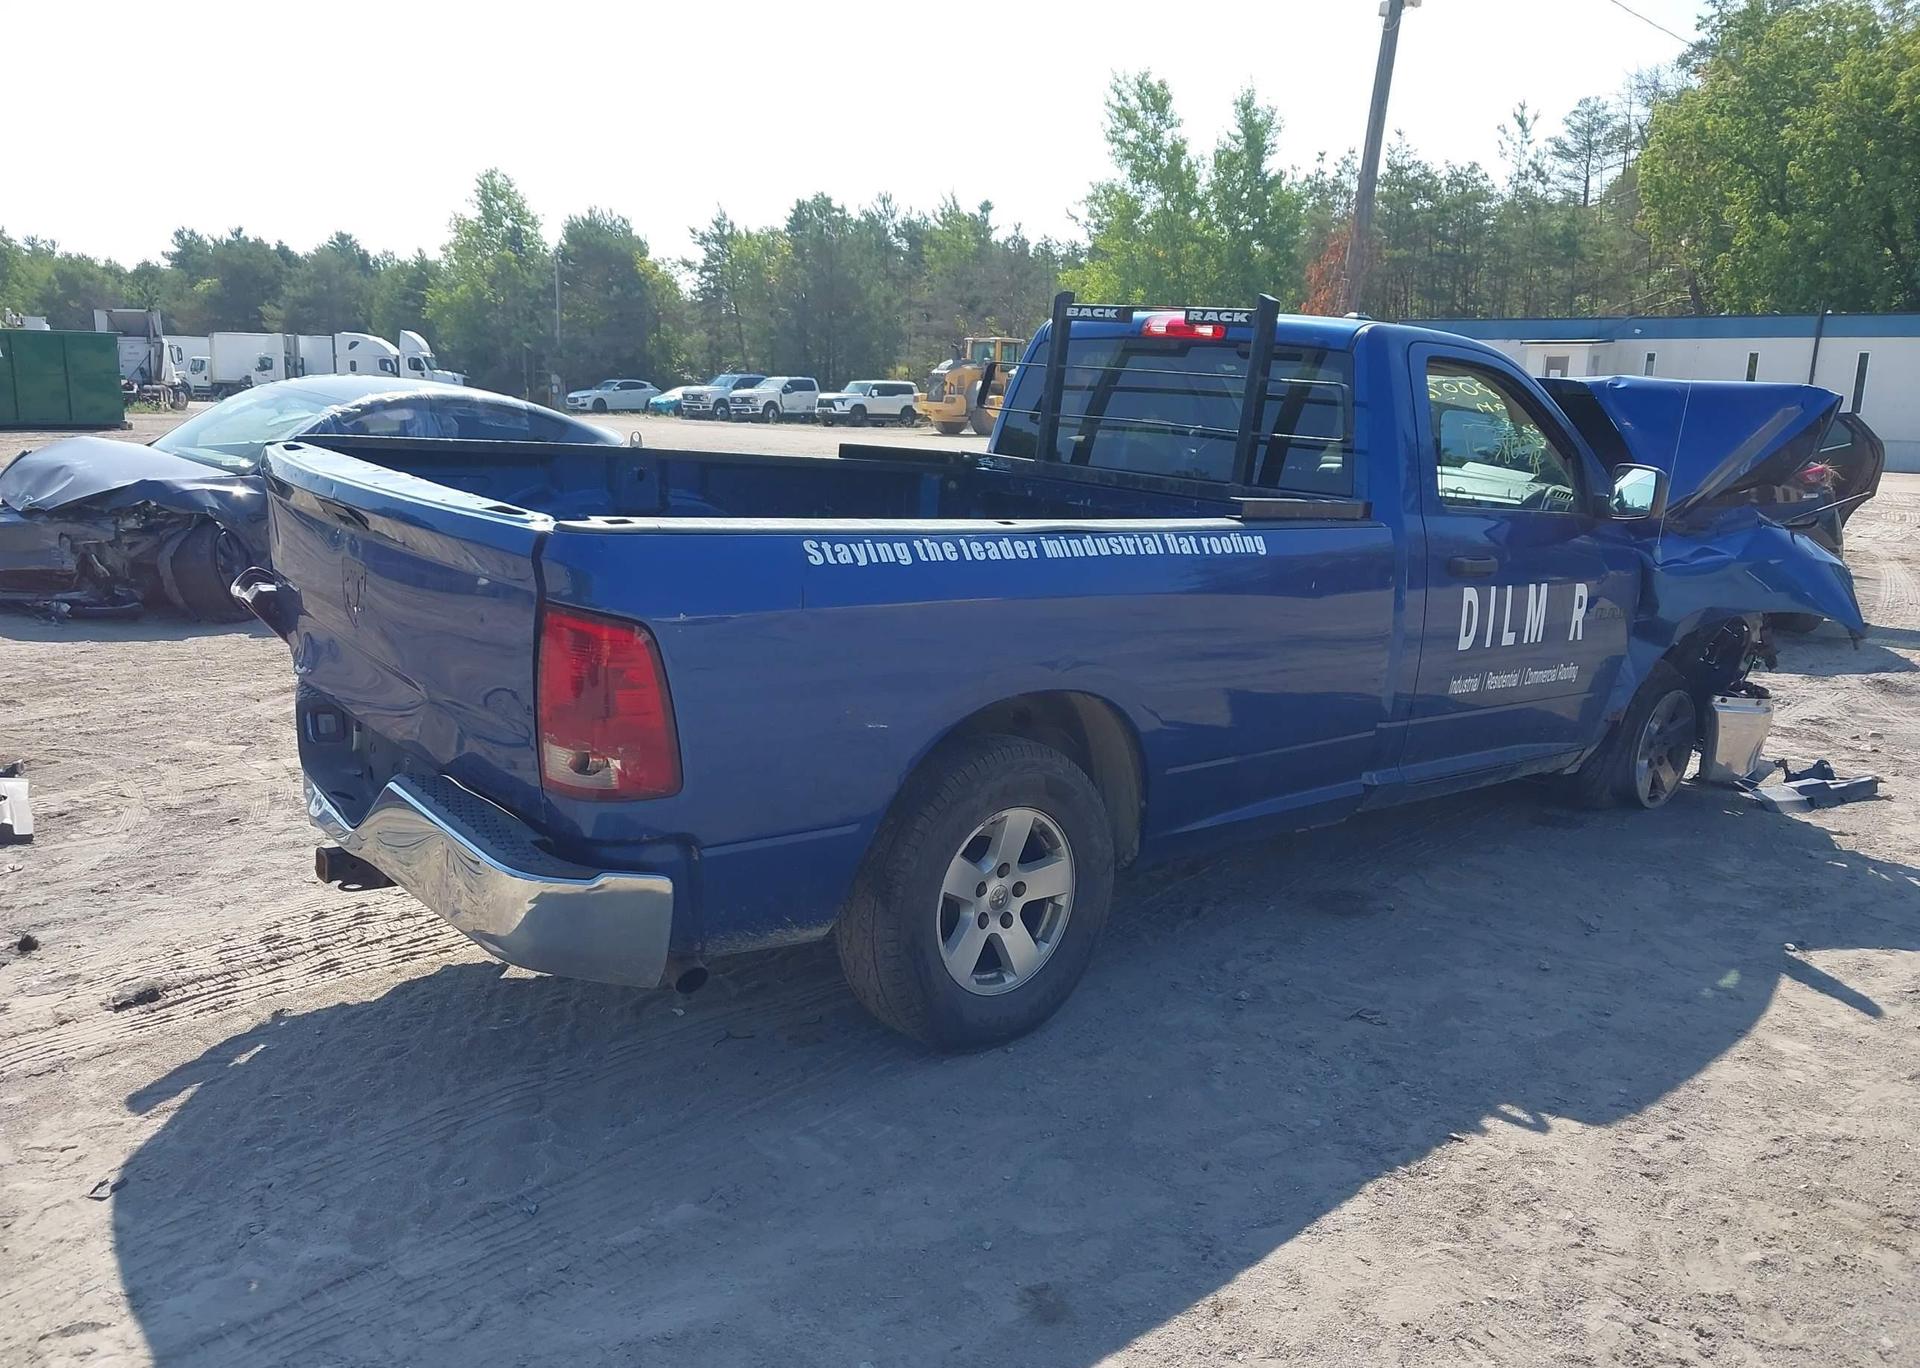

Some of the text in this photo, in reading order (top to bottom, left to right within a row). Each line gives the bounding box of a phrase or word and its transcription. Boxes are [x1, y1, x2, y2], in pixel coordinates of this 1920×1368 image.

[1066, 307, 1118, 319] BACK
[1188, 310, 1250, 323] RACK
[802, 539, 913, 566] Staying
[913, 538, 958, 562] the
[959, 537, 1038, 561] leader
[1164, 533, 1200, 555] flat
[1202, 533, 1267, 555] roofing
[1448, 673, 1482, 695] Industrial
[1485, 669, 1521, 690] Residential
[1524, 664, 1560, 685] Commercial
[1557, 662, 1579, 683] Roofing
